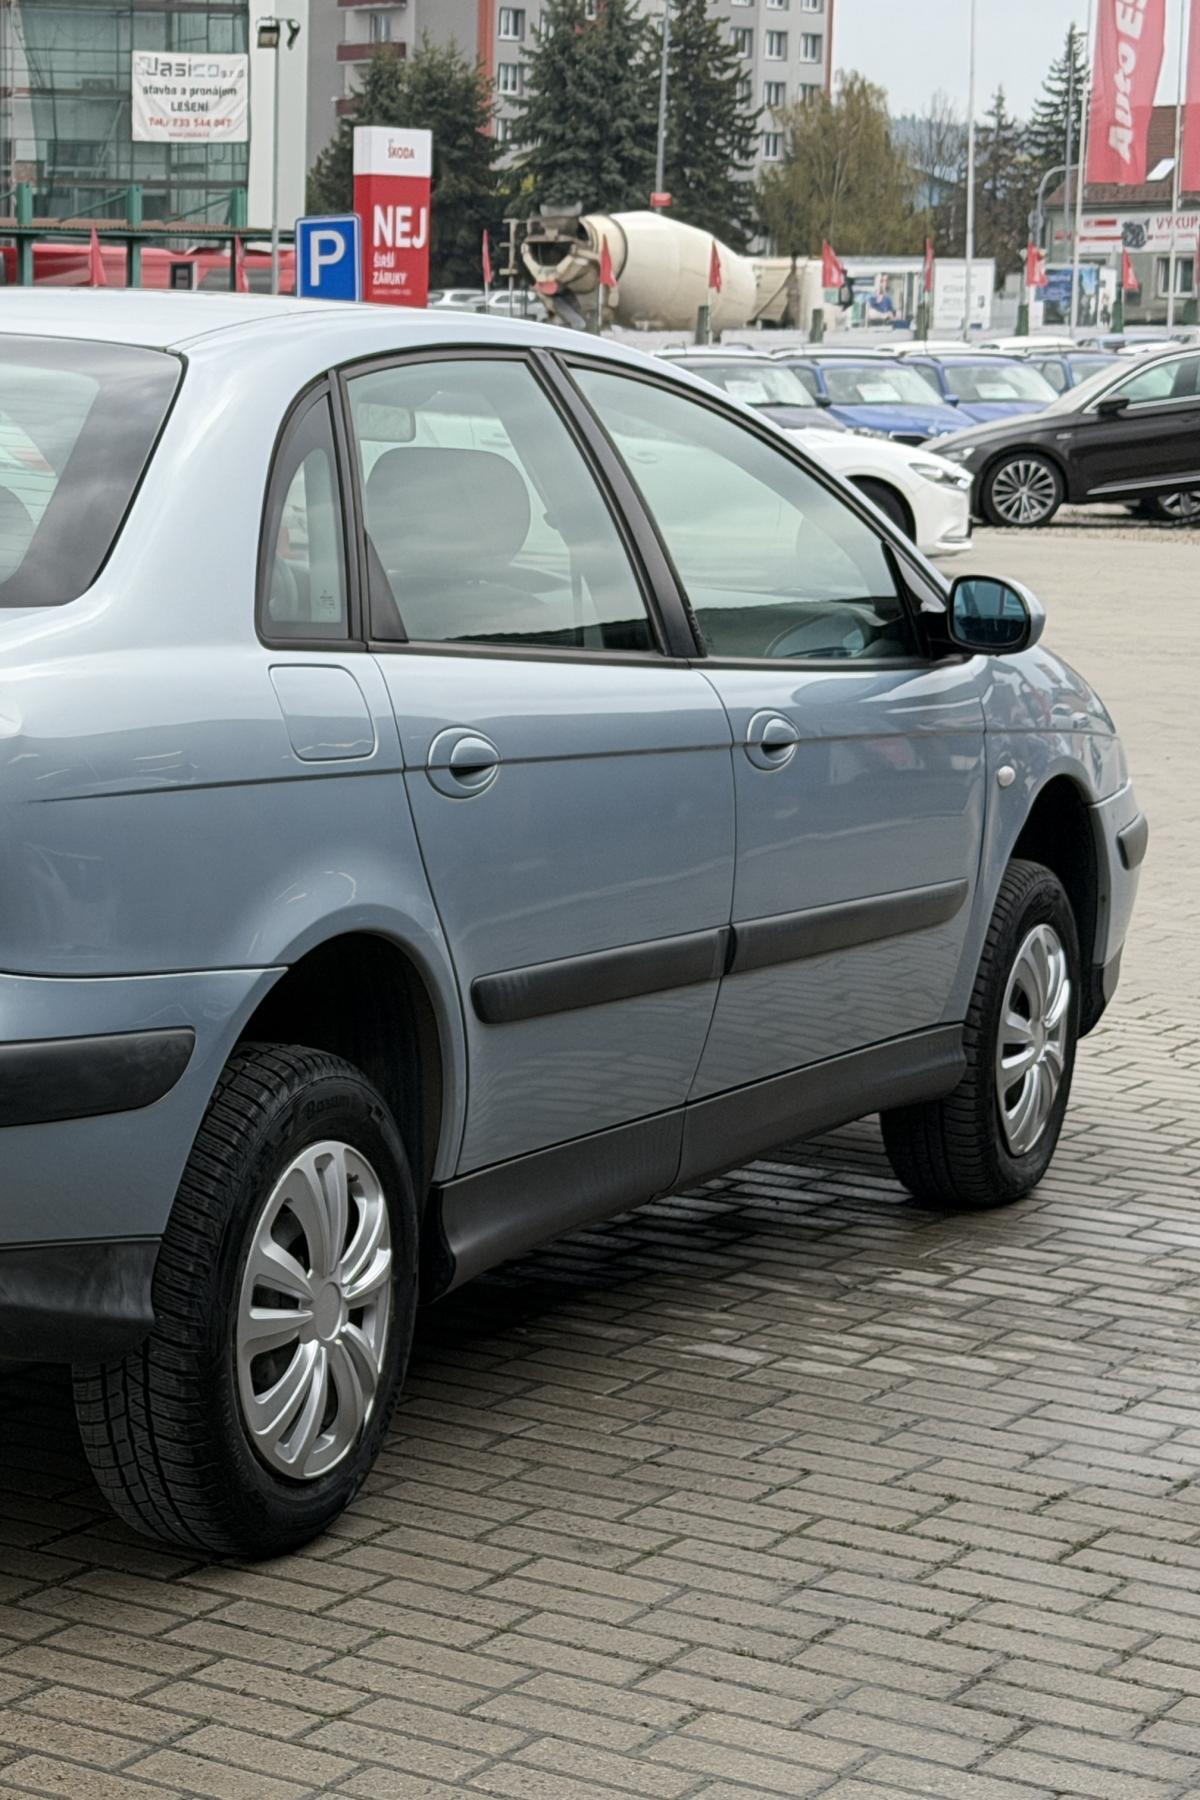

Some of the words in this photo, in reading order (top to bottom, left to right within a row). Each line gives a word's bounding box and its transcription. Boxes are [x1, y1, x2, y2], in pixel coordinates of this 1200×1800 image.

[143, 84, 177, 96] stavba
[180, 87, 187, 96] a
[190, 84, 237, 99] pronájem
[170, 101, 209, 112] LEŠENÍ
[1108, 41, 1136, 165] Auto
[388, 144, 415, 159] ŠKODA
[373, 204, 427, 249] NEJ
[310, 230, 346, 287] P
